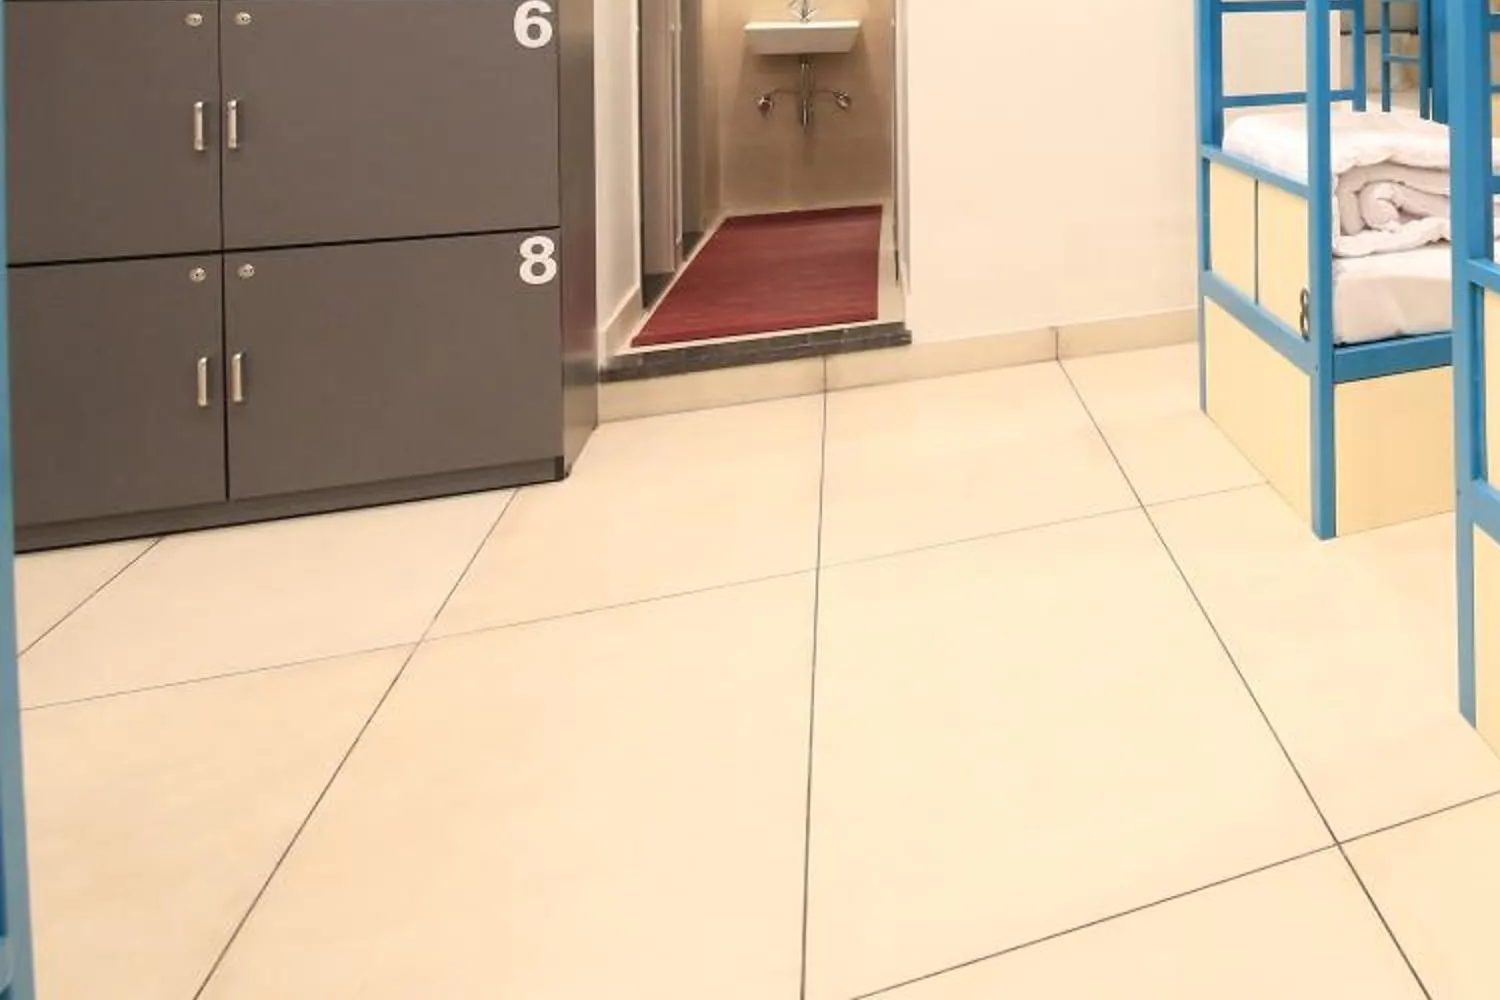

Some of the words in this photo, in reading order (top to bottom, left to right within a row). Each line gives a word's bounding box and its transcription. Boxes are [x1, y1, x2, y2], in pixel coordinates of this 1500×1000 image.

[513, 0, 552, 48] 6
[519, 235, 557, 285] 8
[1300, 287, 1310, 341] 8
